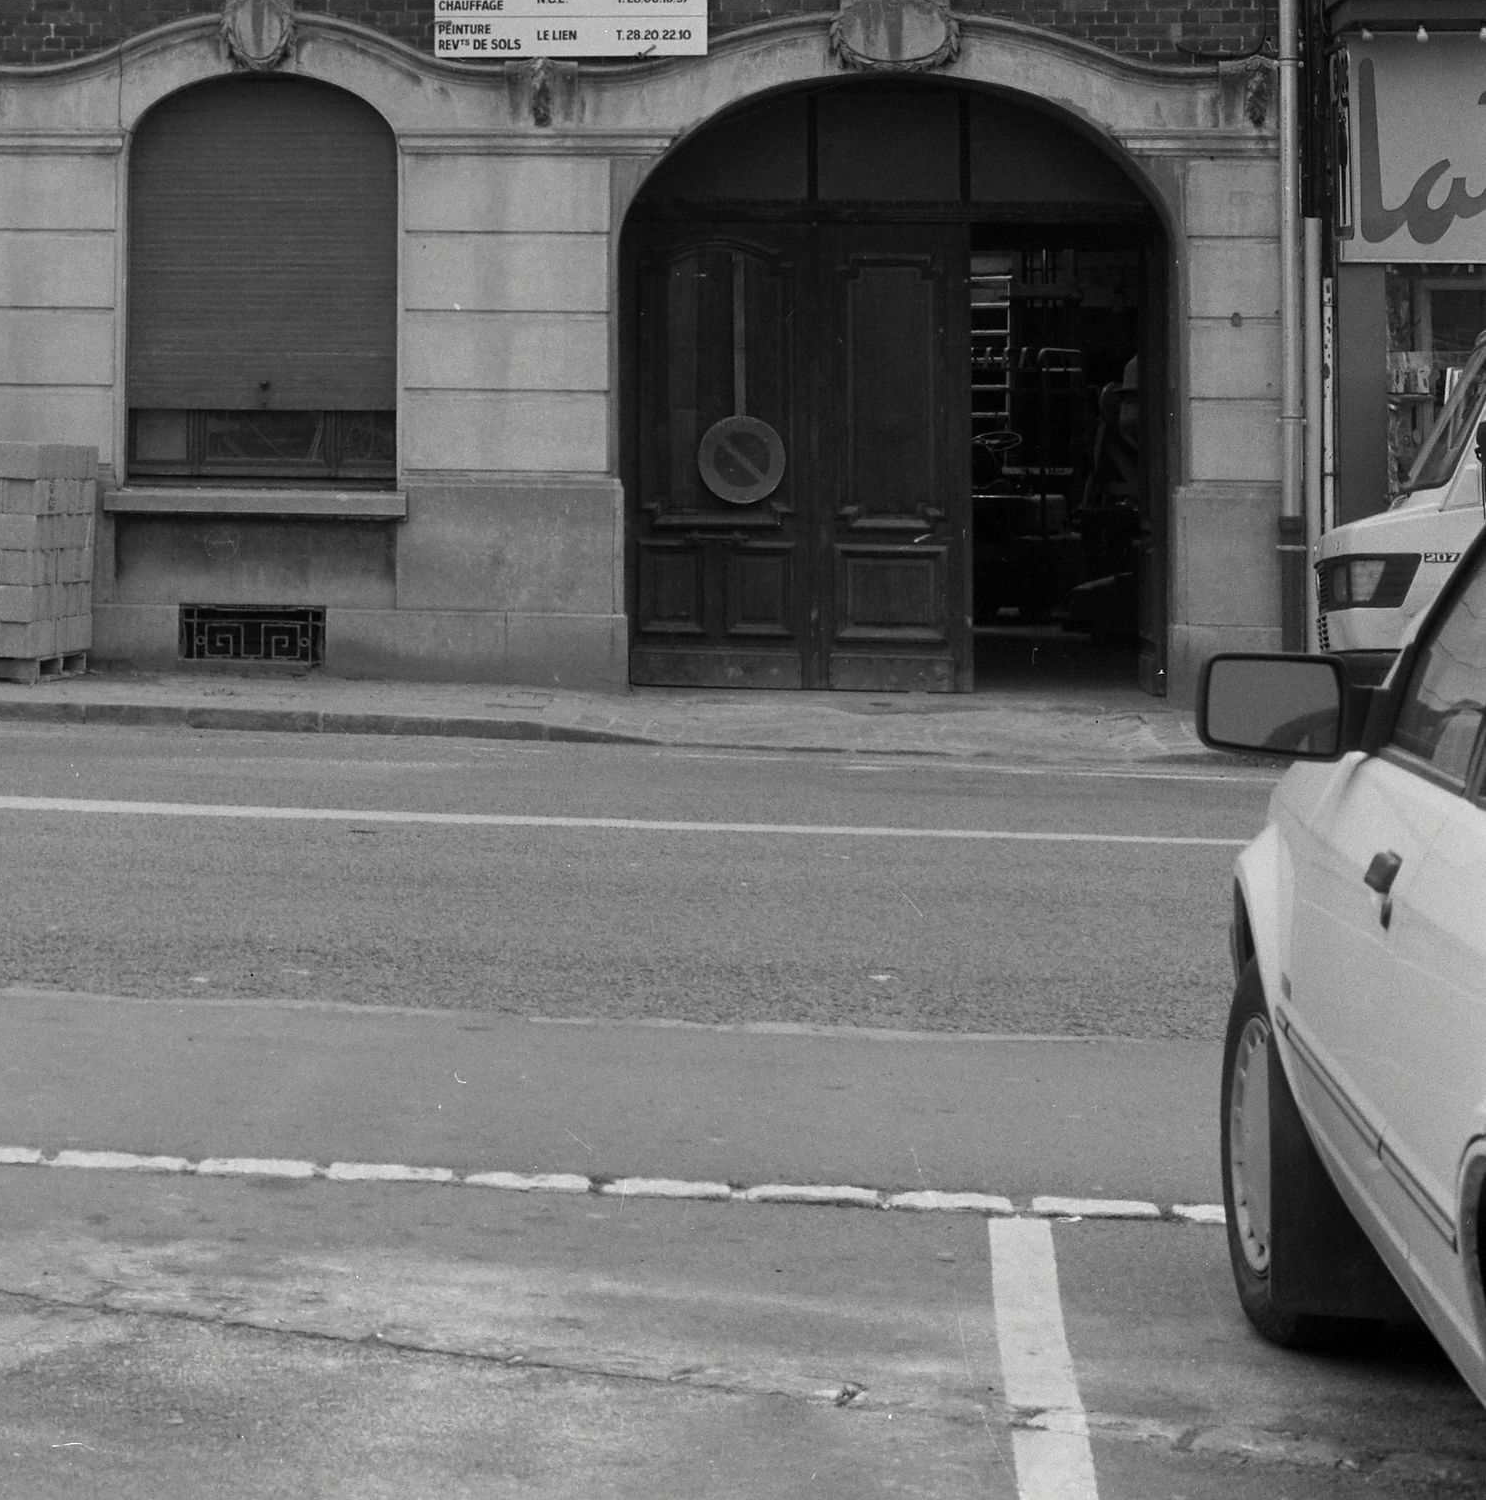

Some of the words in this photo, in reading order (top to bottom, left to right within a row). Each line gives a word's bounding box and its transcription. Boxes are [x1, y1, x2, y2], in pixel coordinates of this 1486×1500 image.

[438, 0, 503, 11] CHAUFFAGE
[438, 24, 491, 35] PEINTURE
[537, 30, 549, 41] LE
[552, 30, 577, 41] LIEN
[473, 39, 488, 50] DE
[491, 39, 521, 50] SOLS
[1425, 553, 1459, 563] 207
